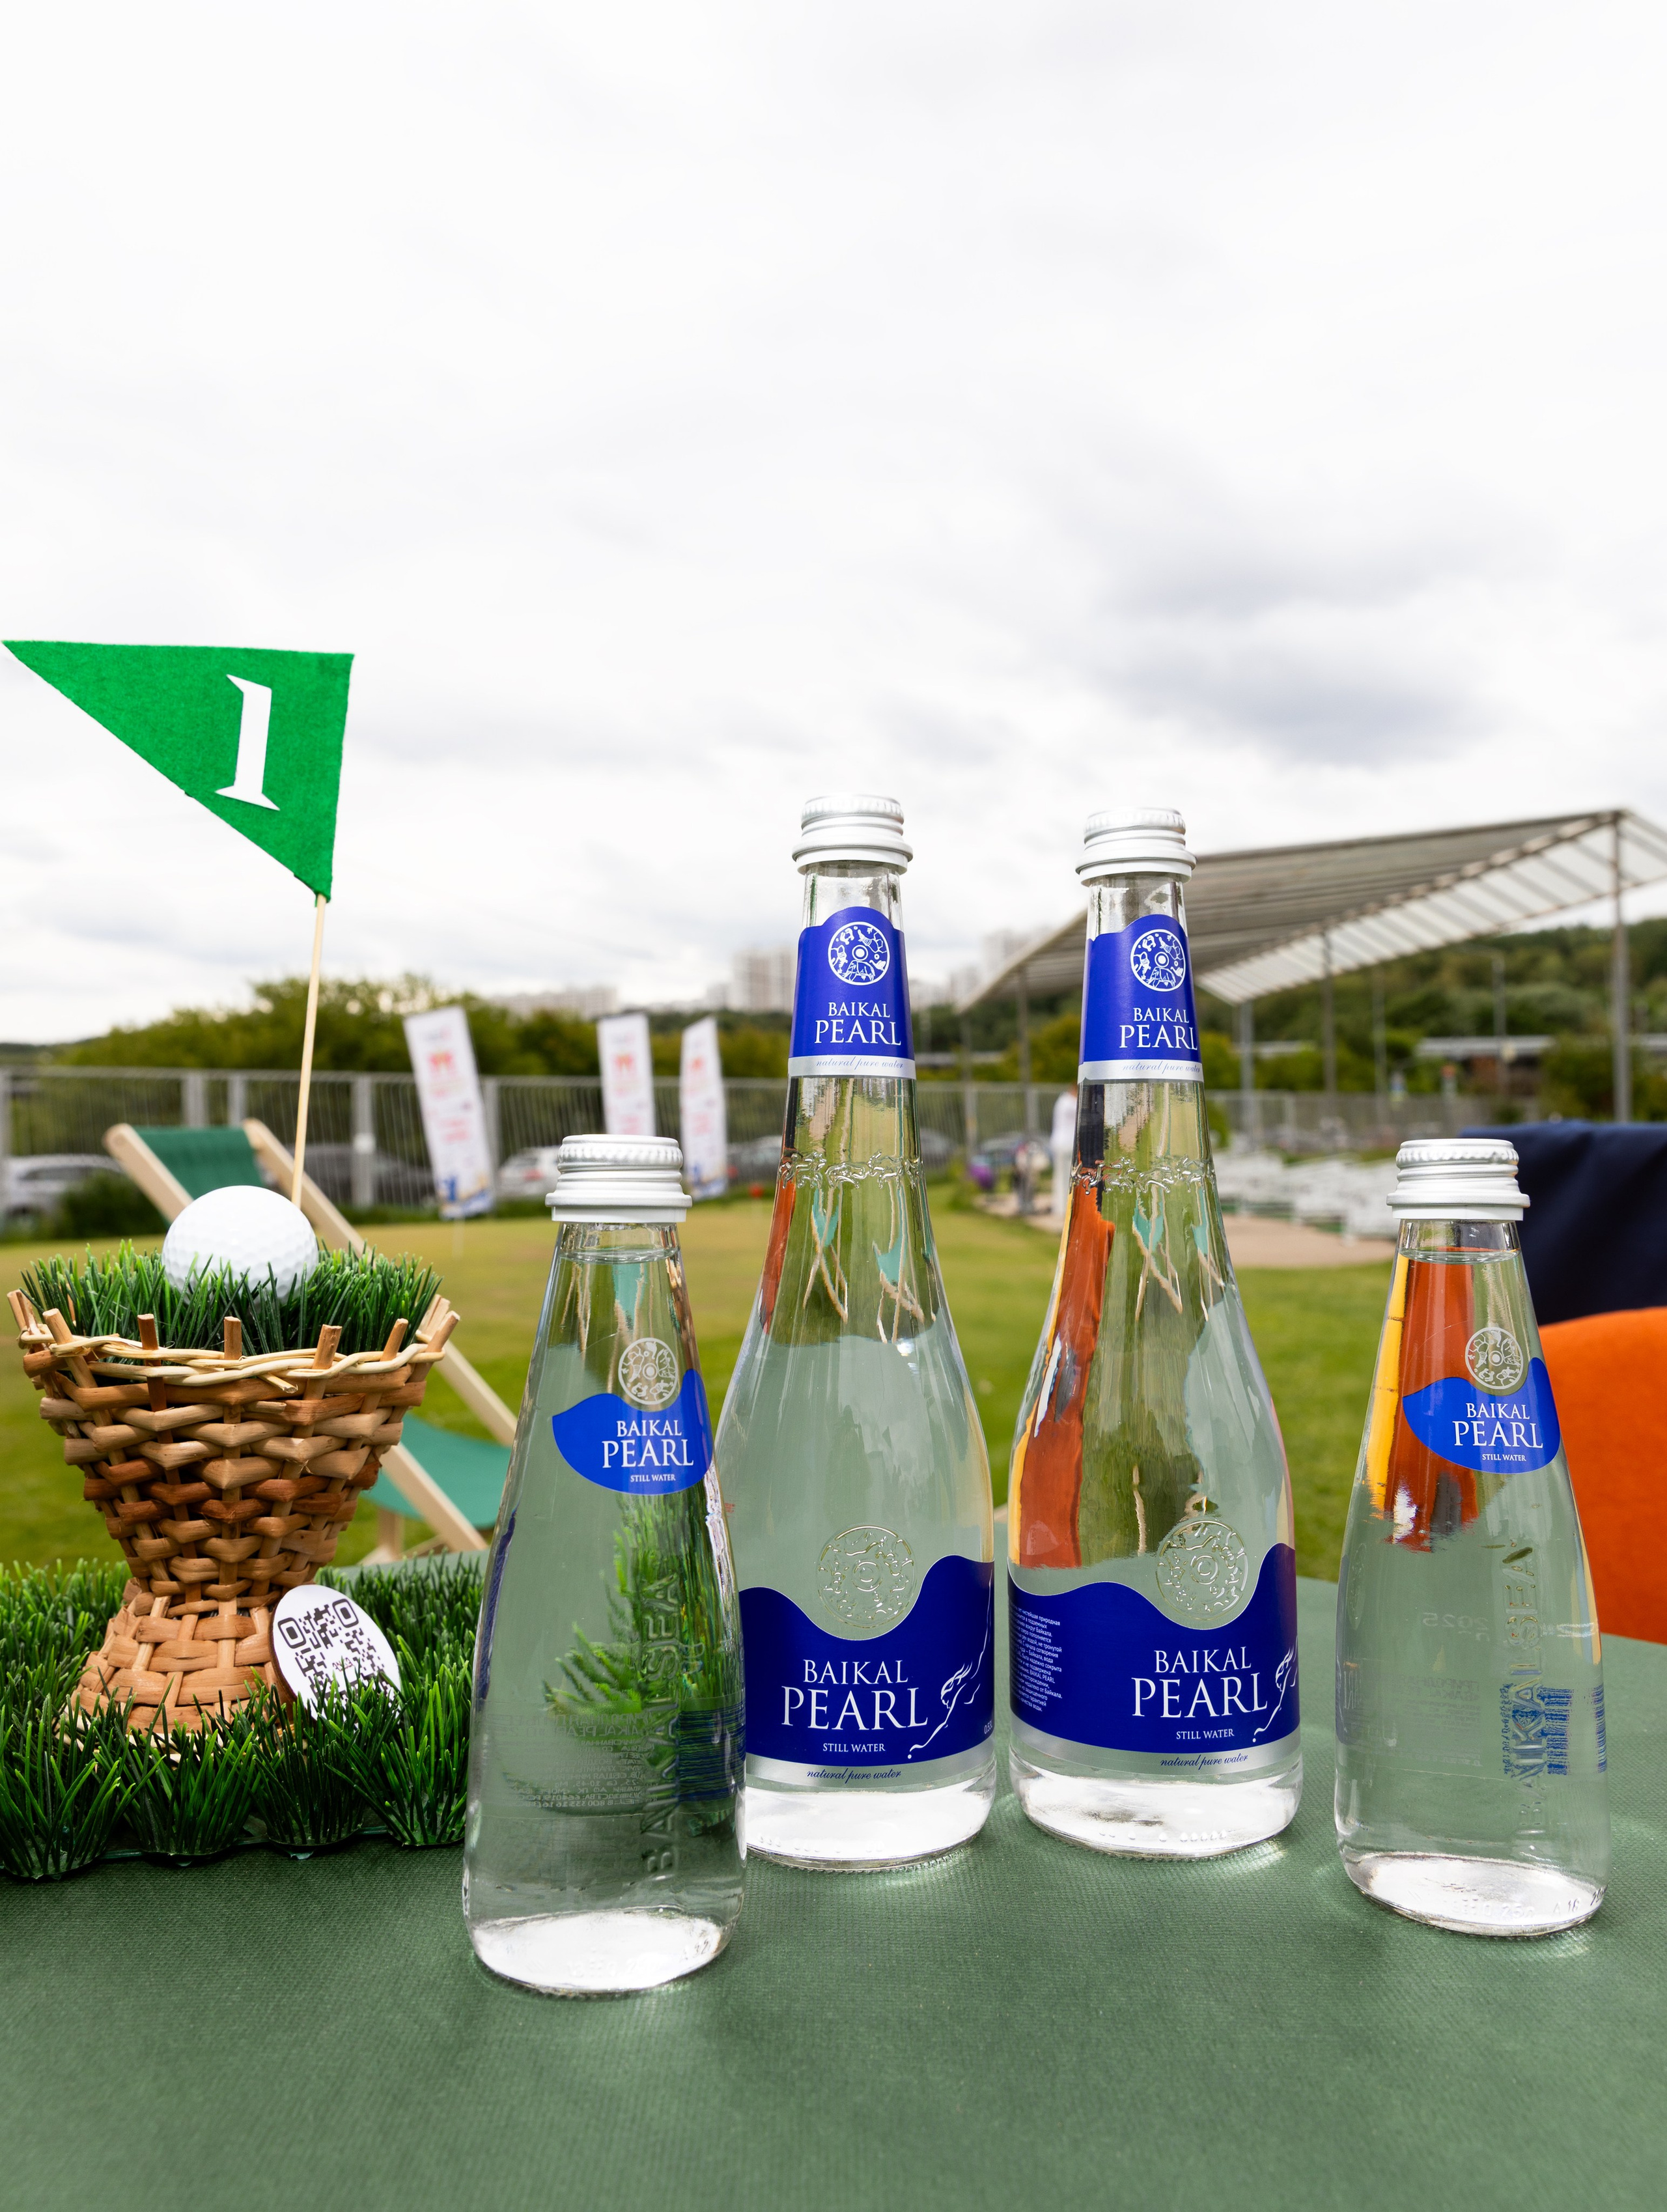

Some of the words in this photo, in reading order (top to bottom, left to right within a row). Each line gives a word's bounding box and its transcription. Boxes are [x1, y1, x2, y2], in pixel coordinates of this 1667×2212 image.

[215, 674, 281, 811] 1
[828, 1001, 891, 1018] BAIKAL
[1133, 1007, 1190, 1024] BAIKAL
[815, 1019, 902, 1046] PEARL
[1119, 1024, 1198, 1051] PEARL
[816, 1056, 856, 1067] natural
[854, 1058, 879, 1071] pure
[882, 1059, 904, 1069] water
[1122, 1060, 1163, 1071] natural
[1162, 1062, 1184, 1074] pure
[1185, 1064, 1201, 1074] water
[1466, 1403, 1530, 1420] BAIKAL
[617, 1420, 682, 1437] BAIKAL
[1452, 1420, 1543, 1449] PEARL
[602, 1439, 694, 1468] PEARL
[1482, 1453, 1502, 1462] STILL
[1502, 1454, 1527, 1463] WATER
[630, 1474, 650, 1483] STILL
[651, 1473, 676, 1482] WATER
[1038, 1616, 1060, 1625] природная
[1035, 1627, 1052, 1636] Байкала.
[1036, 1647, 1058, 1657] сотворения
[1154, 1646, 1252, 1673] BAIKAL
[803, 1659, 908, 1685] BAIKAL
[1030, 1670, 1041, 1678] BAIKAL
[1044, 1688, 1062, 1698] Байкала.
[1131, 1672, 1268, 1718] PEARL
[781, 1686, 928, 1731] PEARL
[1176, 1729, 1201, 1740] STILL
[1203, 1728, 1235, 1739] WATER
[822, 1743, 848, 1752] STILL
[850, 1743, 886, 1753] WATER
[1160, 1754, 1201, 1767] natural
[1198, 1757, 1222, 1771] pure
[1223, 1754, 1248, 1765] water
[807, 1767, 849, 1780] natural
[846, 1770, 872, 1784] pure
[873, 1769, 901, 1780] water
